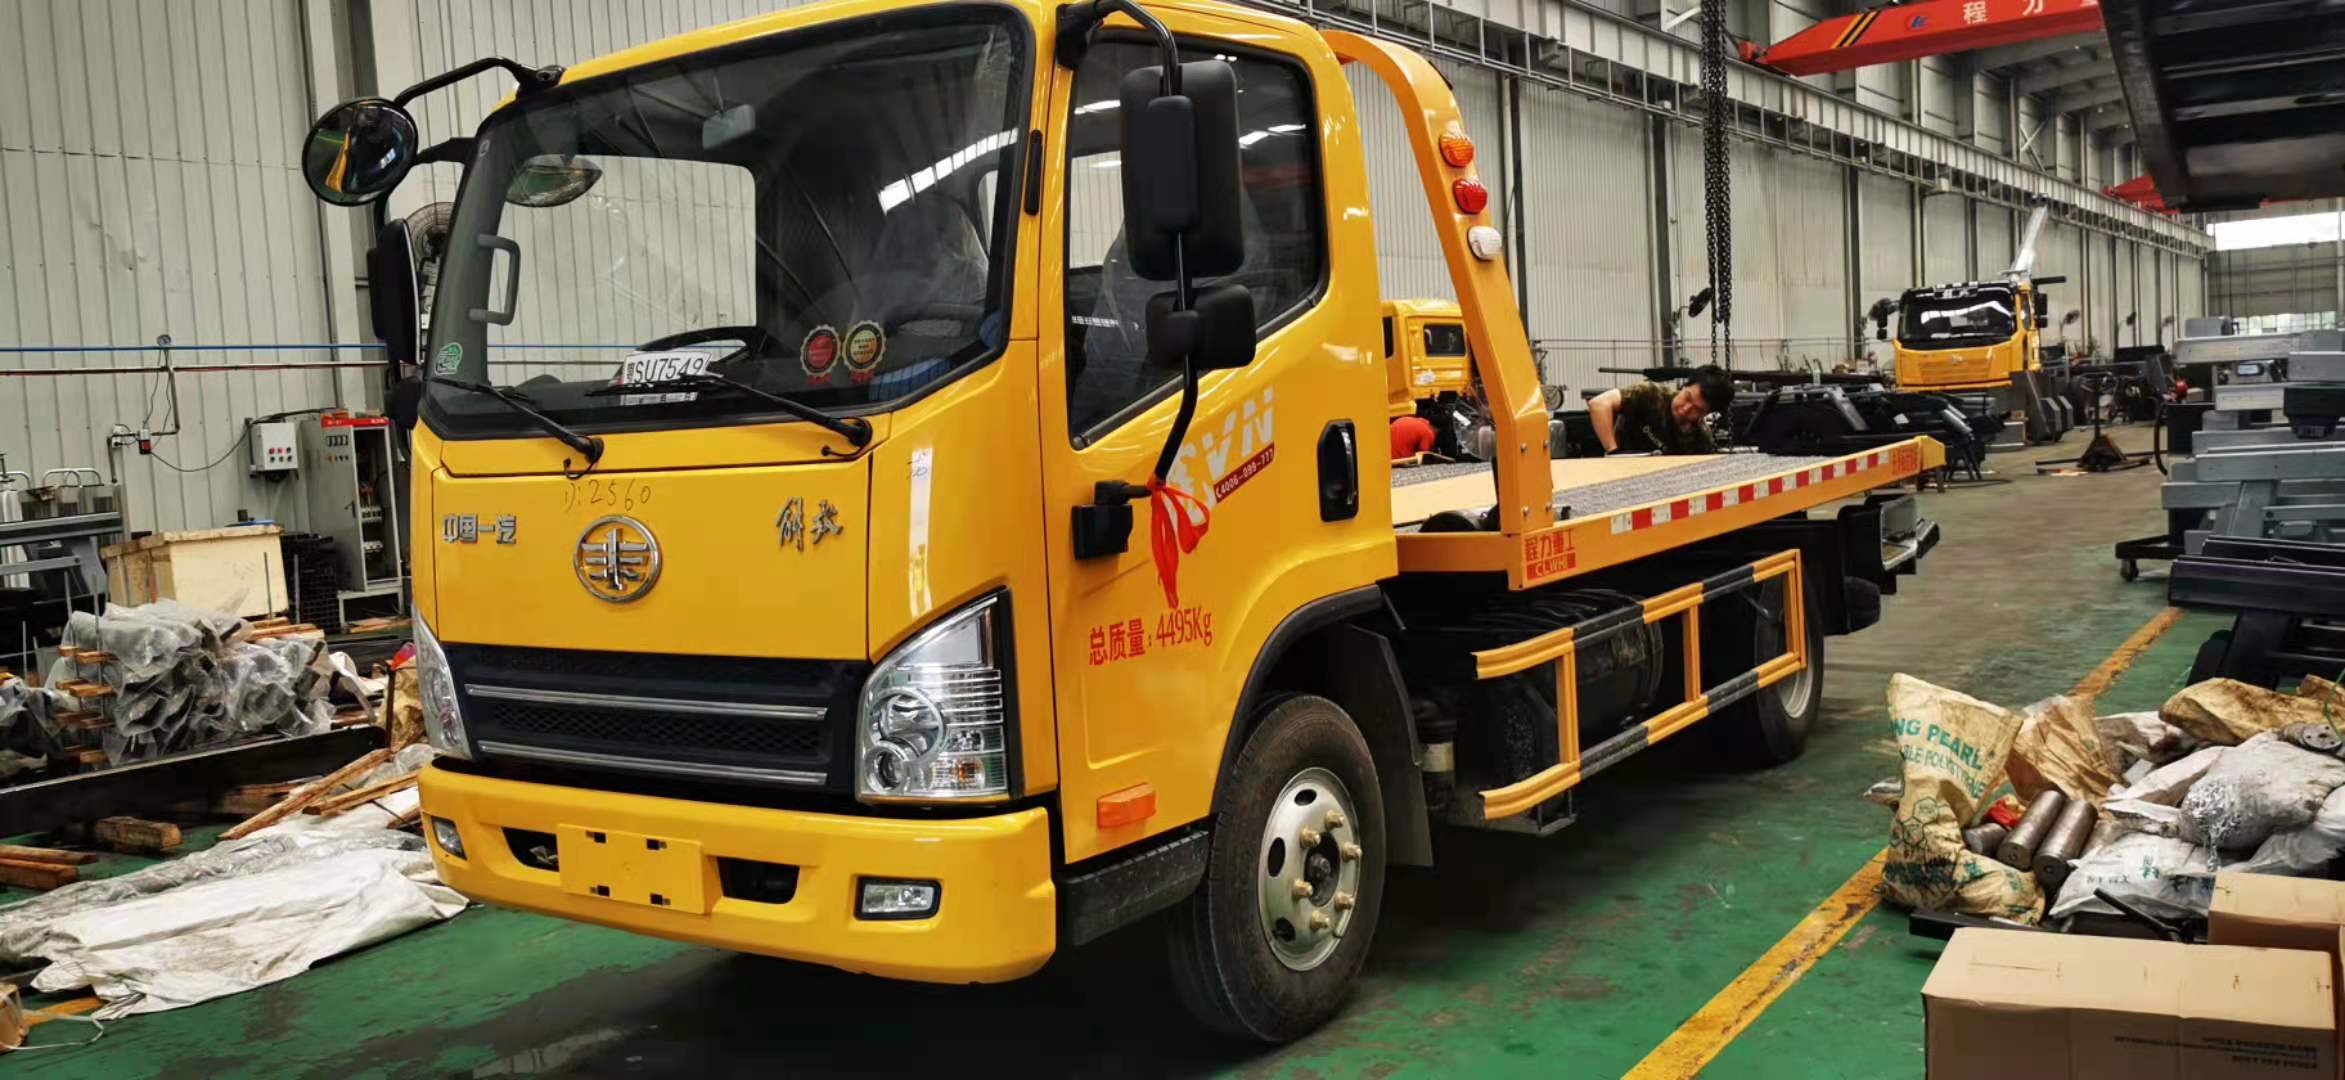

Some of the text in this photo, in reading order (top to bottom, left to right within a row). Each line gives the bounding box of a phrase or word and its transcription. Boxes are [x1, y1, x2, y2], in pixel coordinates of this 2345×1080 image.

[442, 513, 517, 545] 中国一汽
[775, 495, 844, 552] 解放
[1926, 723, 1983, 771] PEARL
